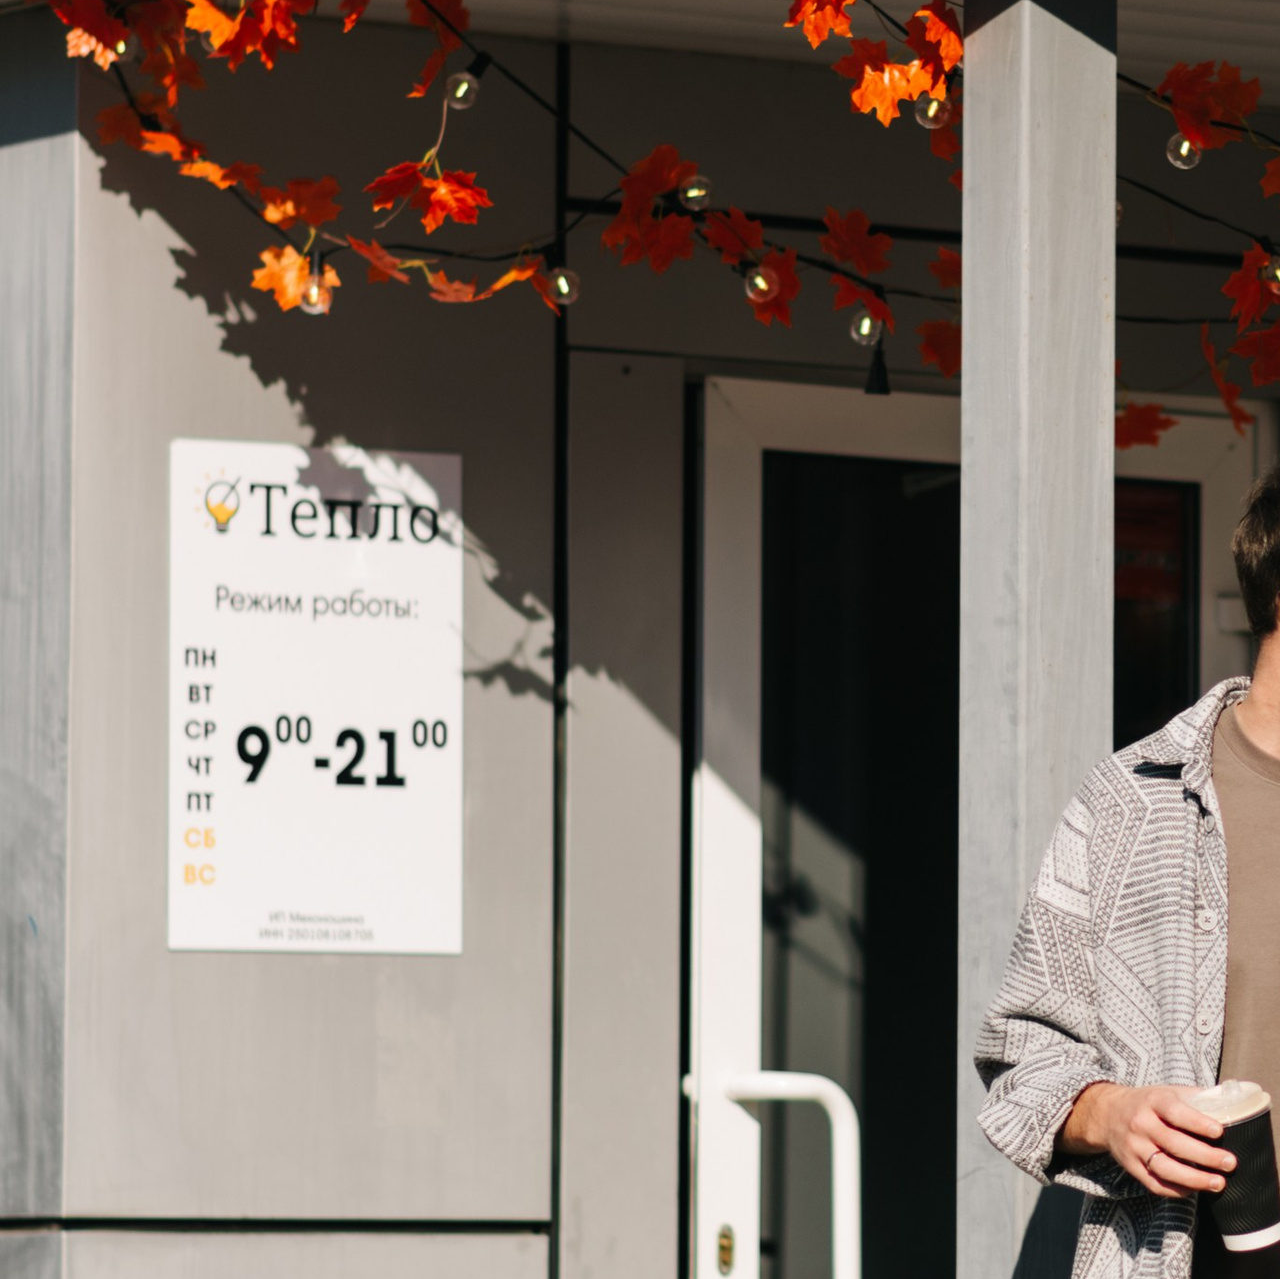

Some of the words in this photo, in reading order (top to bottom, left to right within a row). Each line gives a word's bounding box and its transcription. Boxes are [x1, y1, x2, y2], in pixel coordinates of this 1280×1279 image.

[249, 483, 441, 544] Тепло
[215, 584, 303, 614] Режим
[312, 588, 419, 621] работы:
[184, 647, 217, 668] ПН
[188, 683, 213, 704] ВТ
[184, 720, 217, 740] СР
[187, 756, 213, 776] ЧТ
[186, 792, 214, 812] ПТ
[184, 827, 217, 849] СБ
[184, 864, 216, 886] ВС
